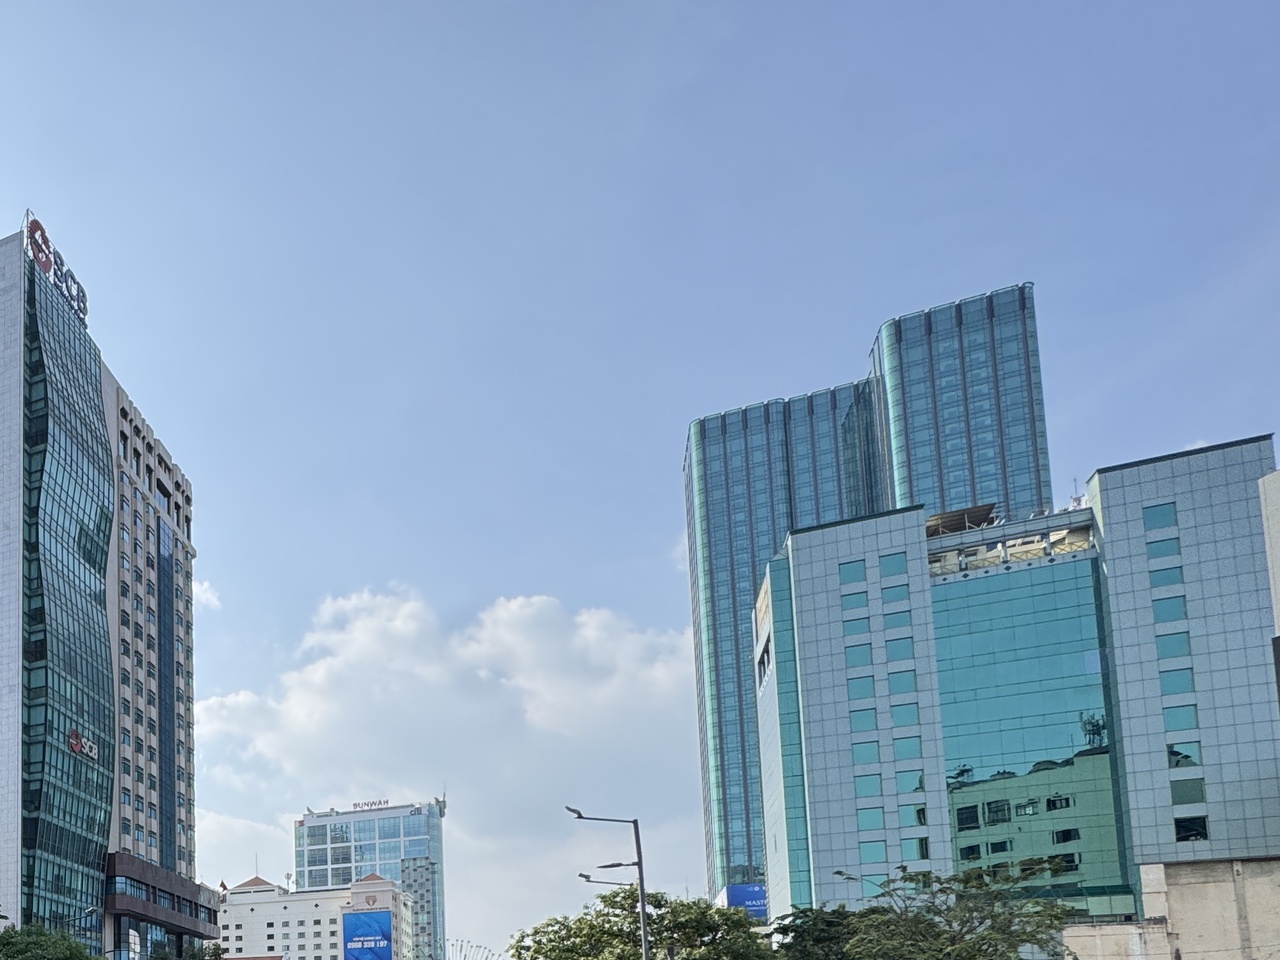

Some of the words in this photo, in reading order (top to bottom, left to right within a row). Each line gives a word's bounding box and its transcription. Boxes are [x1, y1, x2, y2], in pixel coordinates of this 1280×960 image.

[53, 248, 88, 317] SCB
[81, 737, 98, 760] SCB
[352, 799, 389, 810] SUNWAH
